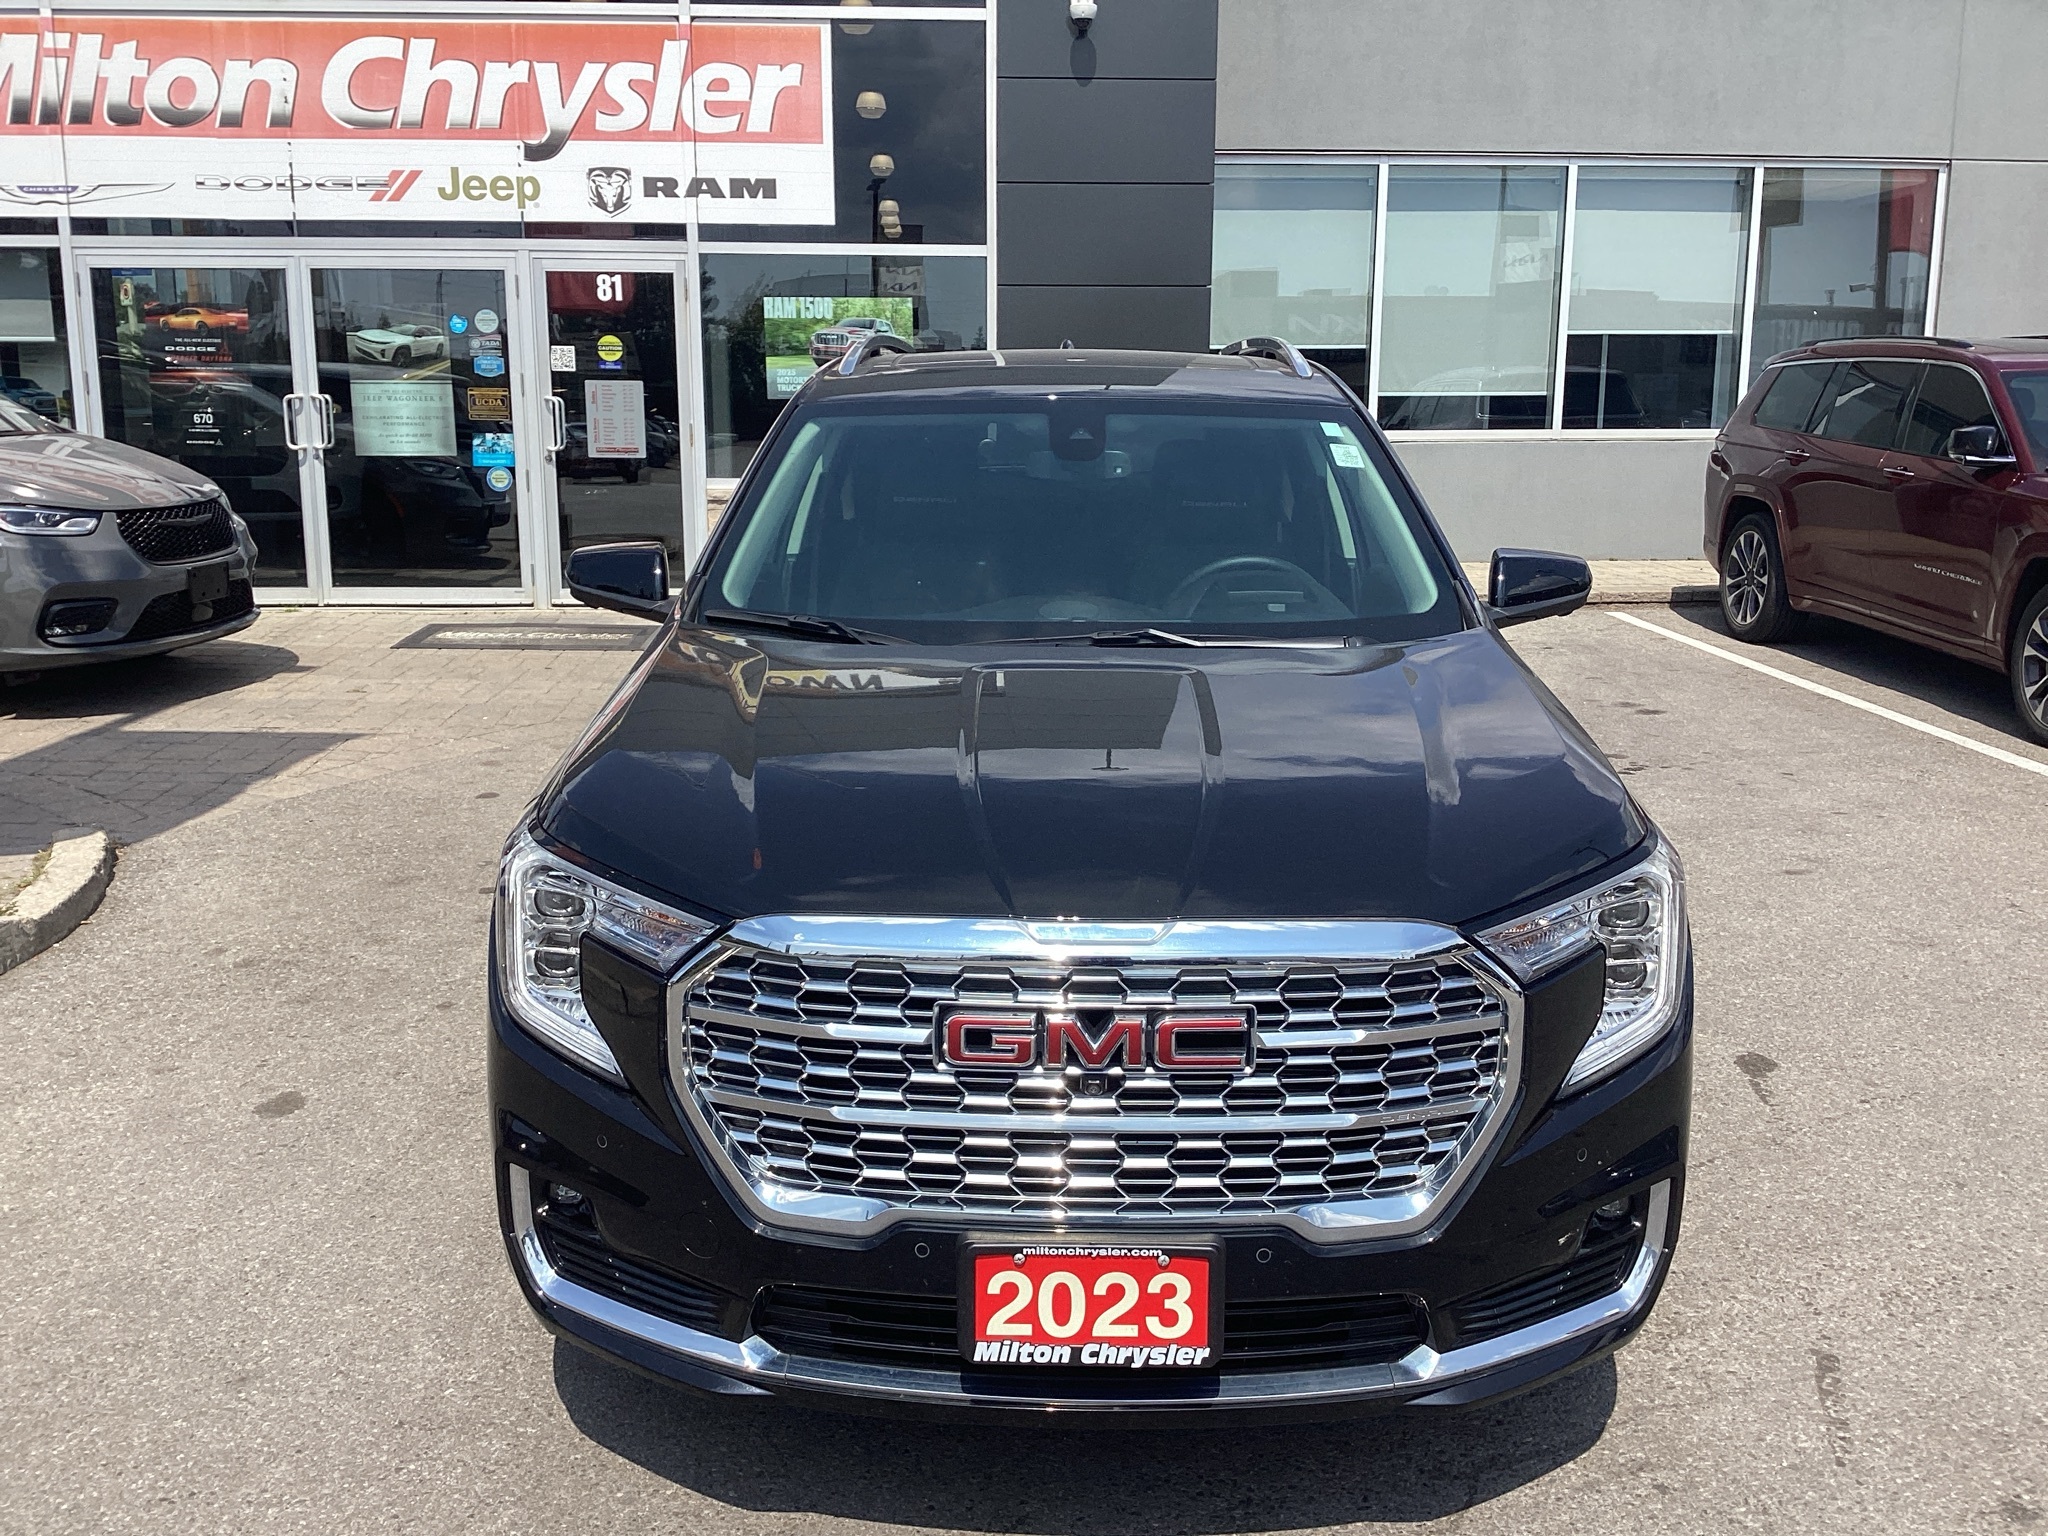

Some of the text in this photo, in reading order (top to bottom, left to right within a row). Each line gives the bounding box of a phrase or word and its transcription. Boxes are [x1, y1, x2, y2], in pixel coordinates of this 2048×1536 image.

[321, 36, 803, 161] Chrysler
[195, 174, 392, 192] DODGE
[437, 167, 541, 210] Jeep
[643, 176, 778, 199] RAM
[596, 273, 624, 302] 81
[763, 297, 833, 319] RAM 1500
[475, 398, 503, 406] UCDA
[193, 413, 214, 424] 670
[945, 1013, 1249, 1069] GMC
[1022, 1245, 1163, 1258] miltonchrysler.com
[985, 1270, 1194, 1340] 2023
[973, 1340, 1212, 1369] Milton Chrysler
